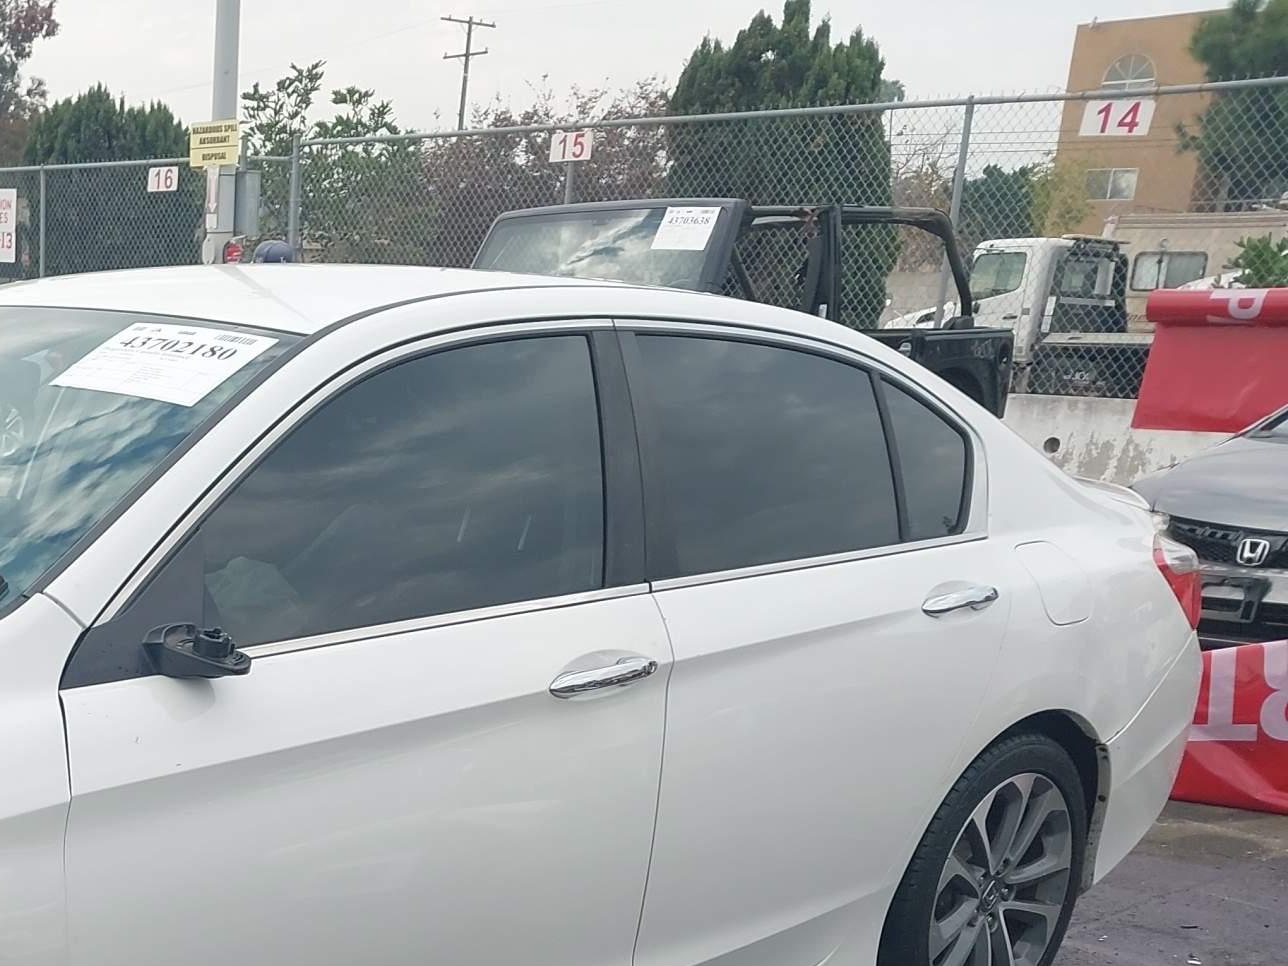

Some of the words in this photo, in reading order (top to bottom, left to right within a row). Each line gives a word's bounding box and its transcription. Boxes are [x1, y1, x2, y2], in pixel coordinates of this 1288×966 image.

[1097, 101, 1141, 133] 14
[559, 133, 585, 159] 15
[154, 169, 173, 189] 16
[119, 335, 238, 361] 43702180
